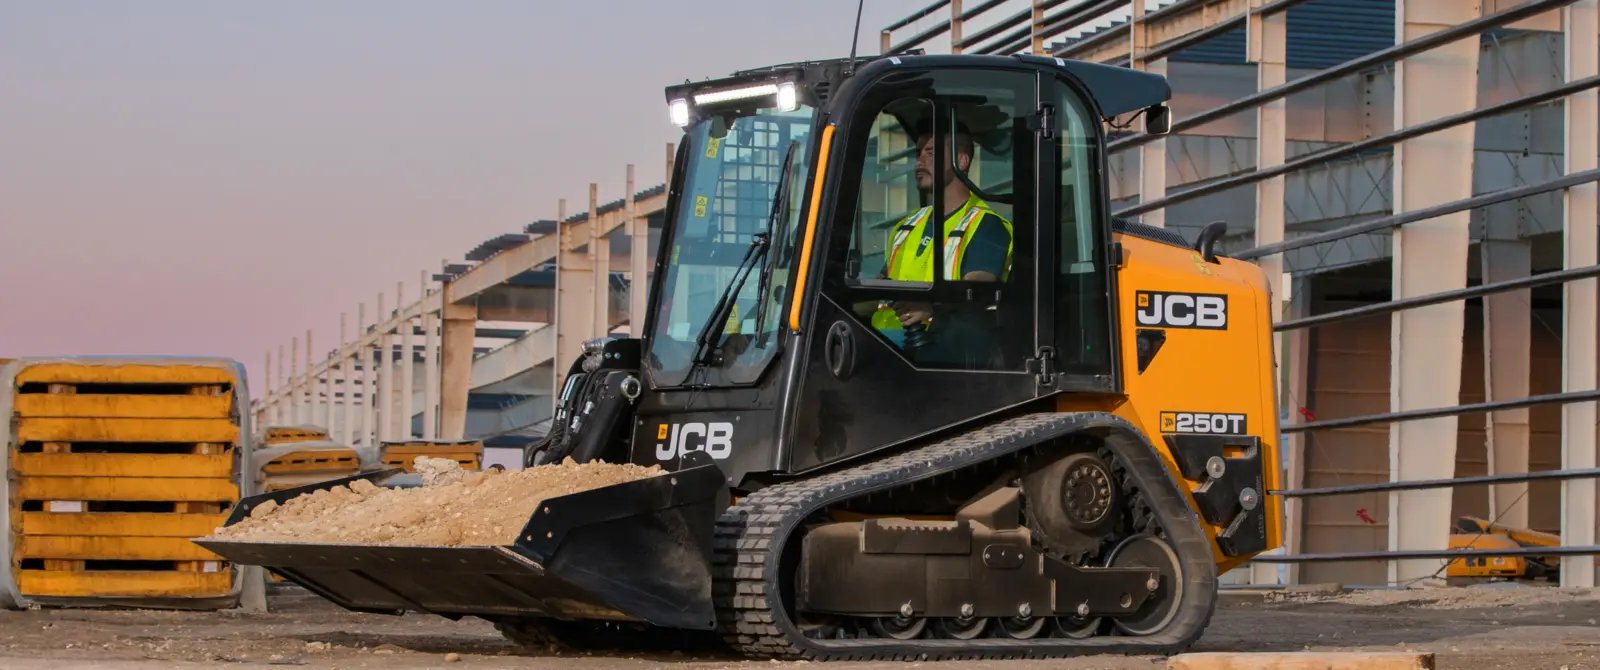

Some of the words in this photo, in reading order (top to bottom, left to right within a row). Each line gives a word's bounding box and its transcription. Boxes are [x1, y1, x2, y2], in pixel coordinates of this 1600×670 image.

[1137, 293, 1226, 327] JCB
[1176, 413, 1245, 434] 250T
[655, 422, 734, 461] JCB
